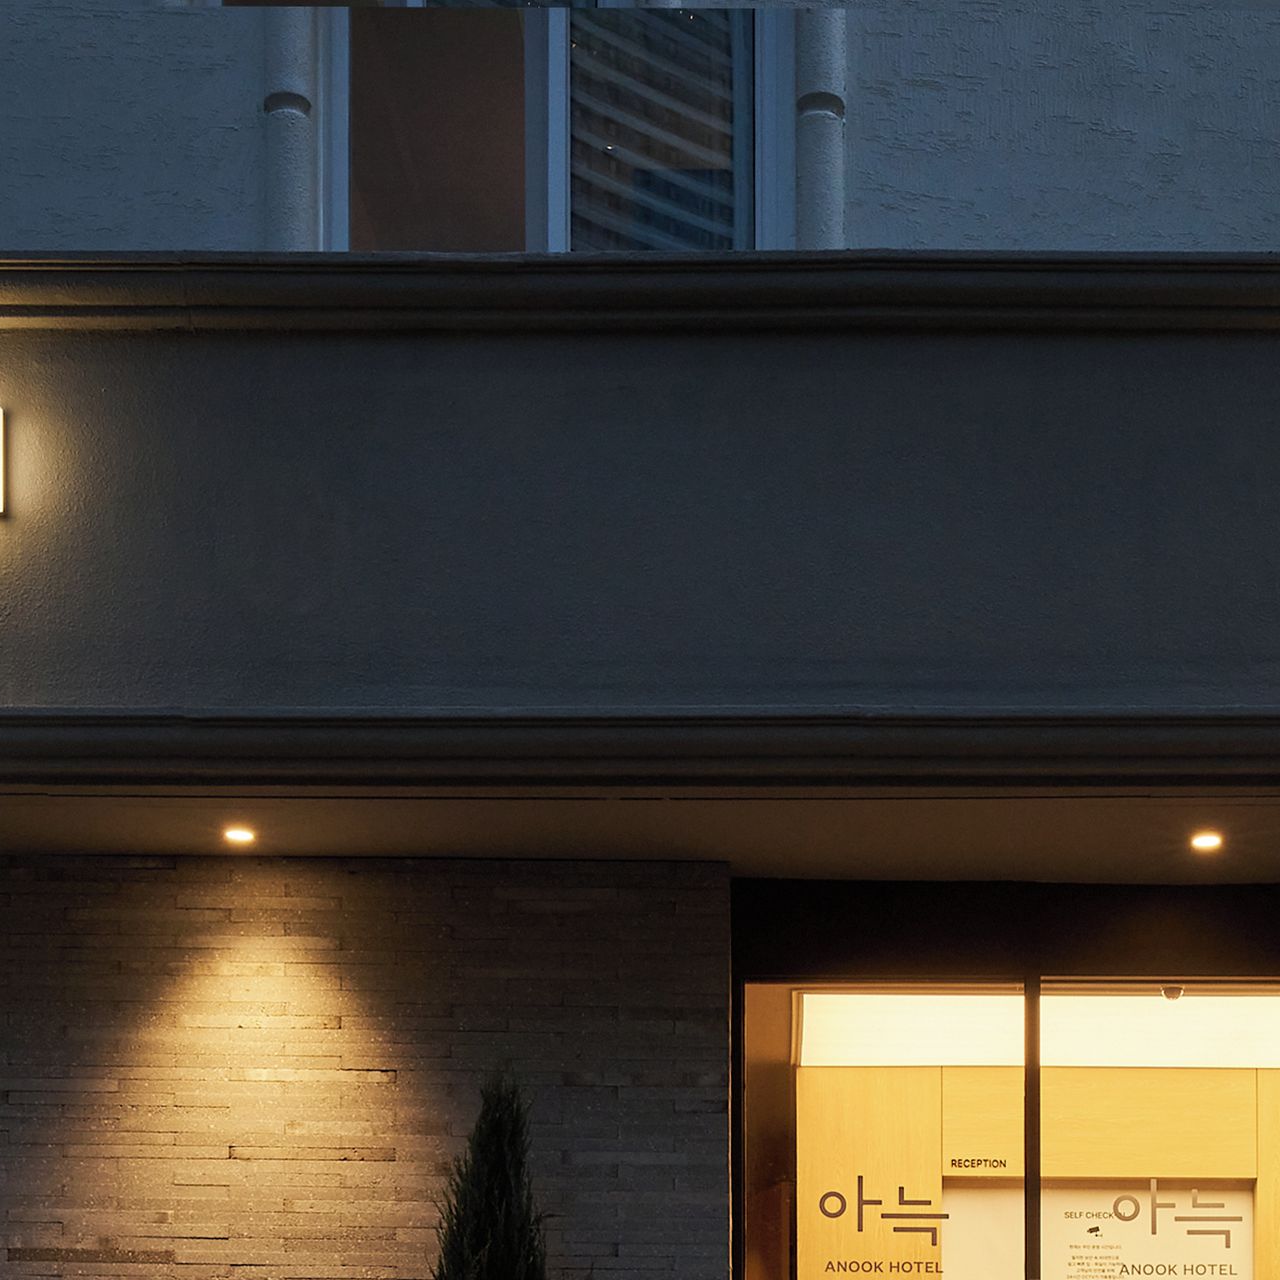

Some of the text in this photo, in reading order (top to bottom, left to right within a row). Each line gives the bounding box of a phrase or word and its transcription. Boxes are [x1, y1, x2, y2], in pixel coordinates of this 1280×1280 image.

[950, 1158, 1007, 1169] RECEPTION
[819, 1175, 950, 1247] 아늑
[1064, 1211, 1084, 1219] SELF
[1113, 1178, 1243, 1249] 아늑
[824, 1260, 944, 1274] ANOOK HOTEL
[1119, 1263, 1238, 1276] ANOOK HOTEL
